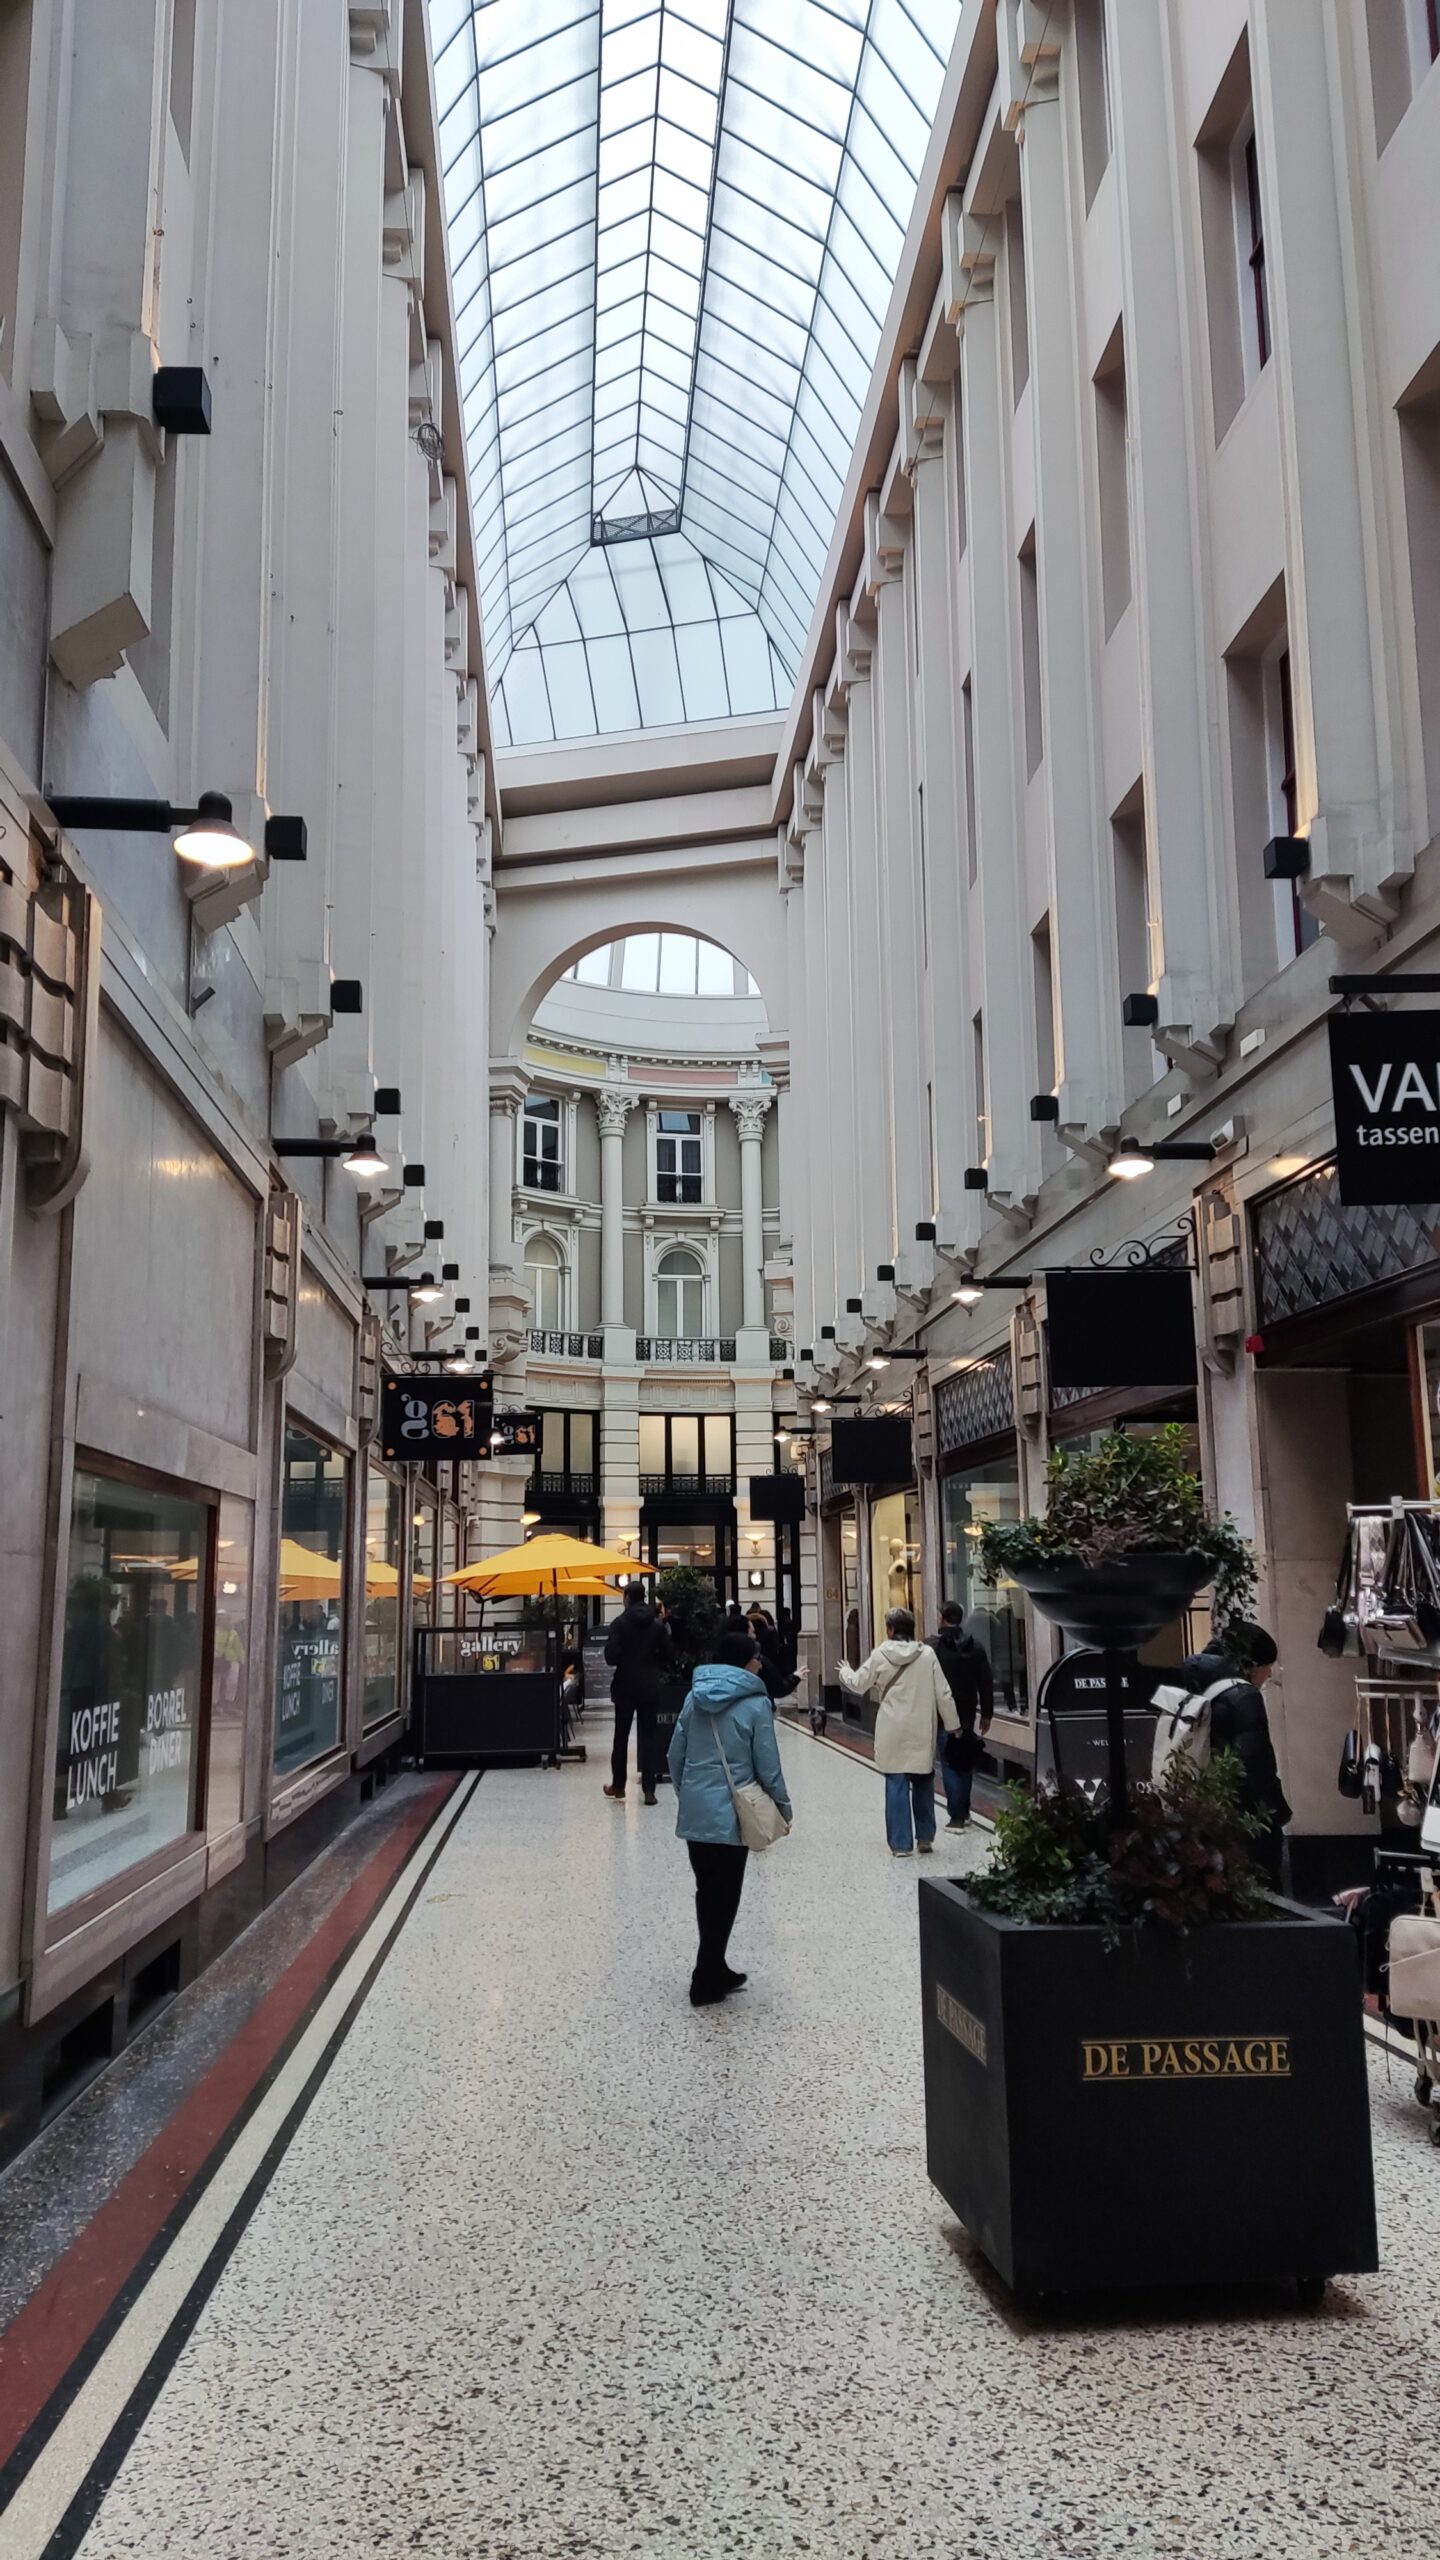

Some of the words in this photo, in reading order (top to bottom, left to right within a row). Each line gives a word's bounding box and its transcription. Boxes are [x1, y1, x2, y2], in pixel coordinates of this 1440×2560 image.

[1348, 1062, 1440, 1113] VA
[1356, 1124, 1439, 1146] tassen
[461, 1636, 521, 1657] gallery
[1074, 1678, 1088, 1688] DE
[1090, 1677, 1129, 1688] PASE
[70, 1702, 120, 1755] KOFFIE
[147, 1688, 187, 1731] BORREL
[149, 1730, 182, 1775] DINER
[66, 1750, 118, 1809] LUNCH
[1083, 2044, 1130, 2076] DE
[1141, 2041, 1290, 2074] PASSAGE
